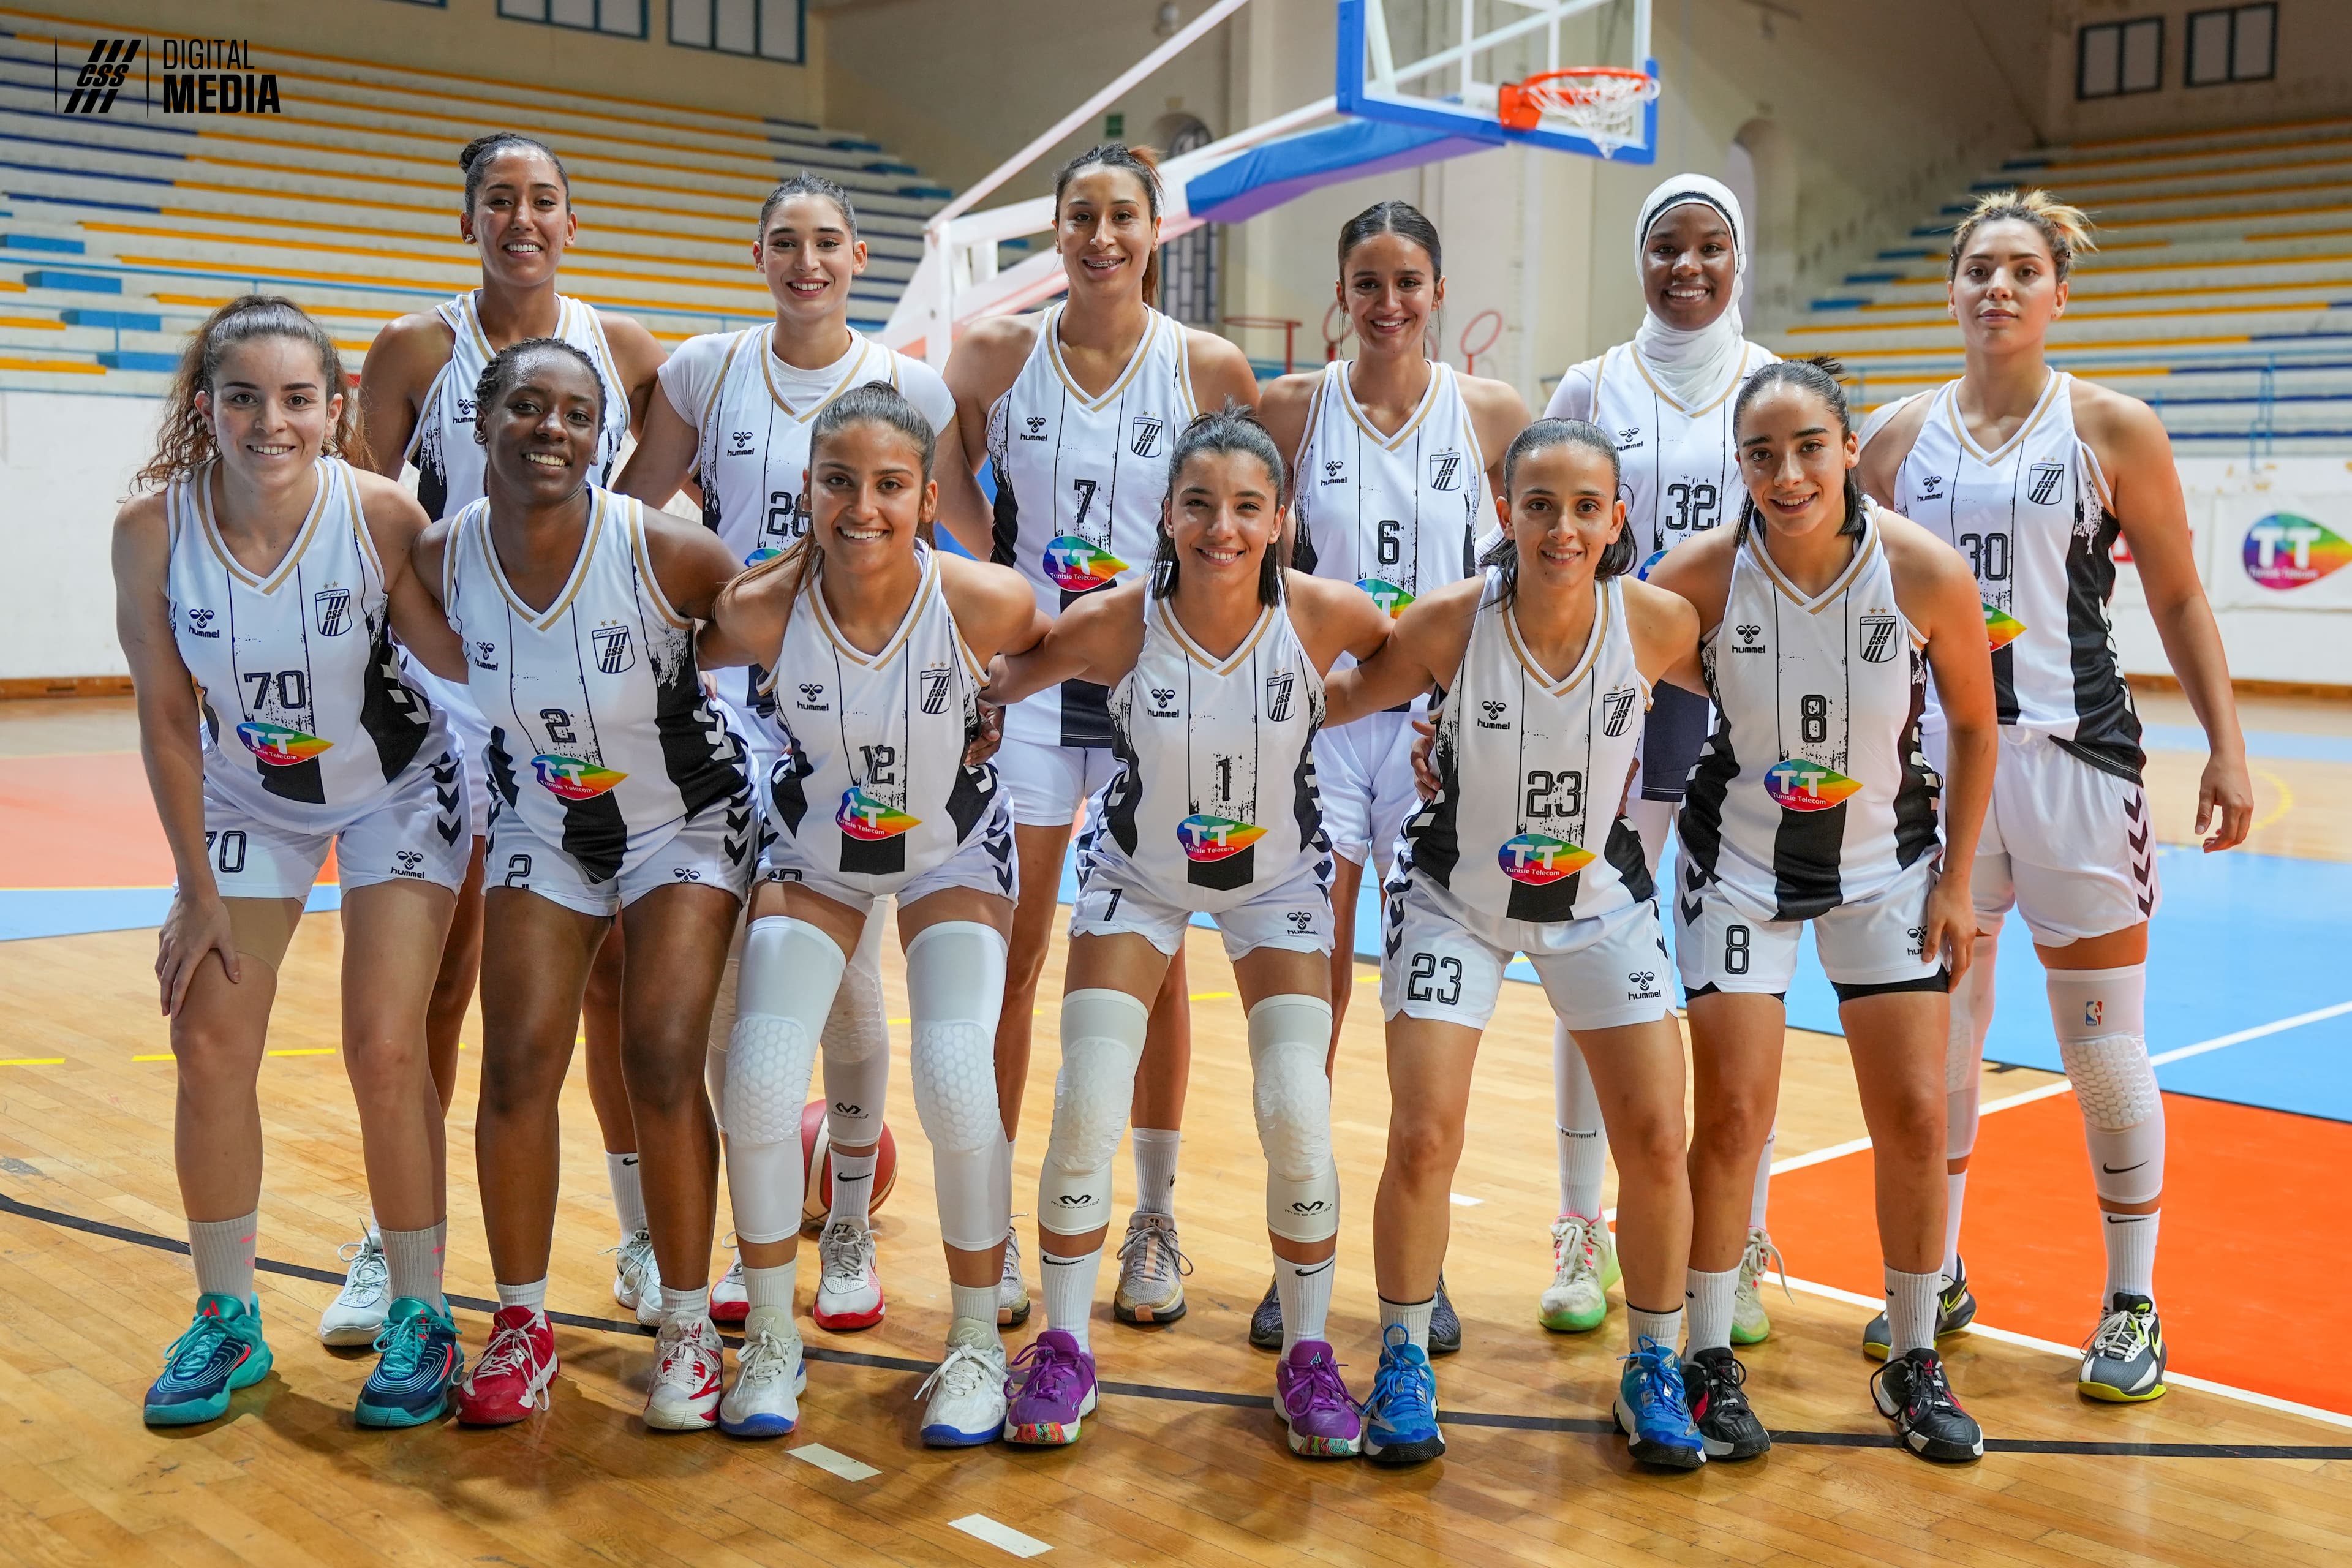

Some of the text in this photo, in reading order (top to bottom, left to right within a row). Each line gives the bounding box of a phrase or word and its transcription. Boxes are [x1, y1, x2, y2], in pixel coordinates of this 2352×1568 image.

[1020, 433, 1048, 442] hummel
[1139, 434, 1156, 443] CSS
[727, 448, 755, 457] hummel
[1616, 441, 1643, 452] hummel
[1438, 468, 1455, 477] CSS
[1321, 477, 1348, 486] hummel
[2037, 480, 2056, 489] CSS
[1074, 479, 1096, 524] 7
[1917, 491, 1943, 502] hummel
[1665, 484, 1717, 531] 32
[1378, 520, 1400, 565] 6
[2250, 527, 2321, 569] TT
[1049, 548, 1096, 575] TT
[1960, 533, 2008, 581] 30
[325, 609, 343, 620] CSS
[189, 626, 220, 638] hummel
[1869, 635, 1889, 645] CSS
[605, 646, 624, 657] CSS
[1732, 644, 1766, 654] hummel
[474, 658, 499, 671] hummel
[244, 670, 306, 710] 70
[929, 688, 948, 698] CSS
[797, 701, 829, 711] hummel
[1275, 693, 1291, 706] CSS
[1147, 708, 1180, 718] hummel
[1611, 709, 1629, 720] CSS
[1801, 695, 1827, 743] 8
[540, 709, 577, 743] 2
[1477, 718, 1510, 730] hummel
[242, 727, 295, 754] TT
[246, 744, 298, 761] Tunisie Telecom
[859, 744, 895, 785] 12
[534, 760, 585, 786] TT
[540, 778, 594, 794] Tunisie Telecom
[1218, 758, 1230, 802] 1
[1772, 769, 1826, 797] TT
[1526, 771, 1582, 818] 23
[1772, 791, 1826, 805] Tunisie Telecom
[845, 792, 886, 827] TT
[837, 815, 885, 835] Tunisie Telecom
[1184, 823, 1235, 847] TT
[1185, 842, 1206, 854] Tunisie
[1507, 844, 1562, 870] TT
[391, 867, 425, 878] hummel
[1506, 865, 1529, 875] Tunisie
[1725, 925, 1750, 975] 8
[1907, 947, 1925, 957] hum
[1408, 952, 1463, 1006] 23
[1628, 989, 1661, 1001] hummel
[1561, 1128, 1597, 1139] hummel
